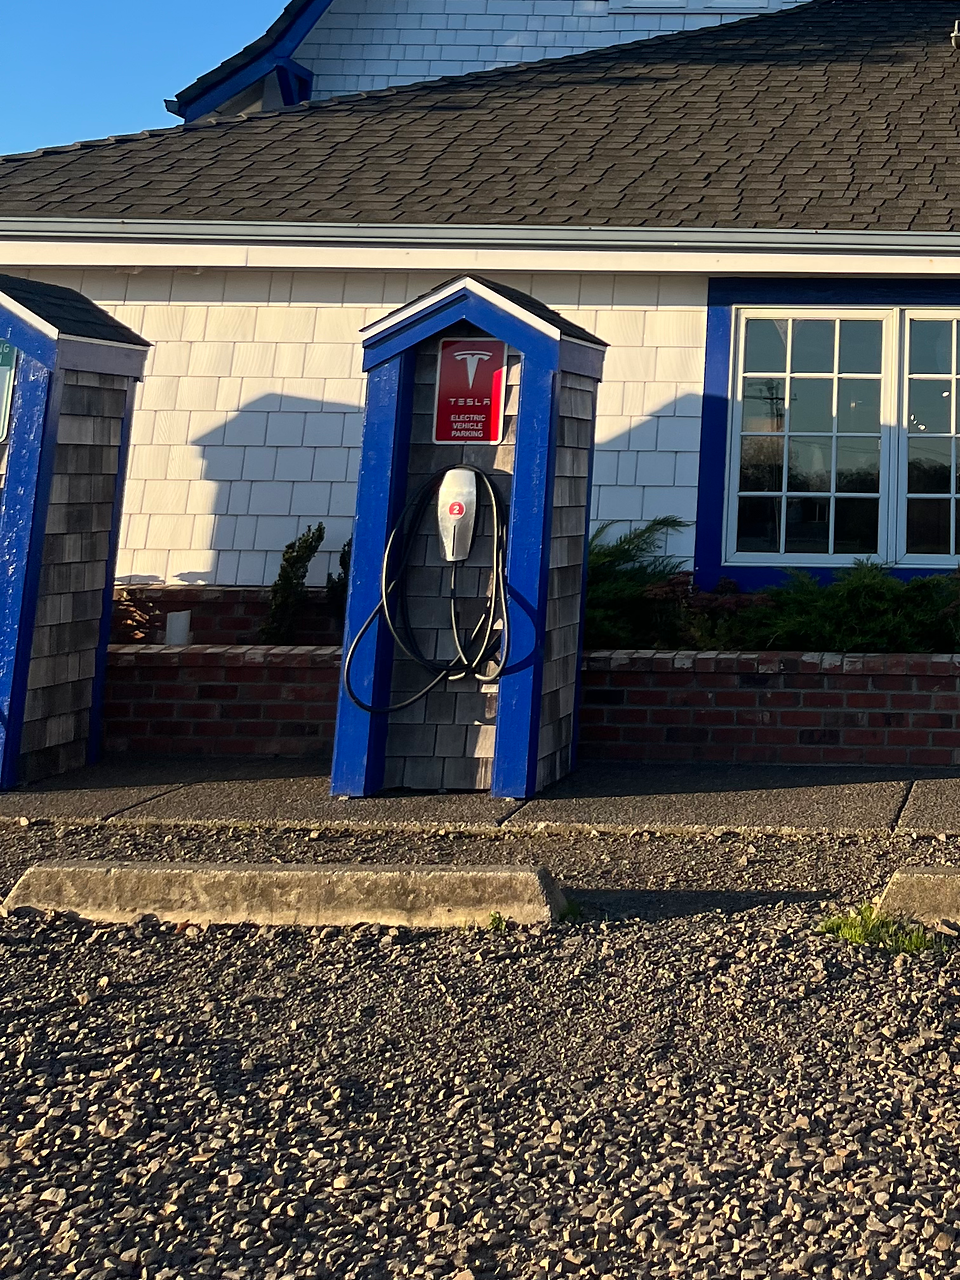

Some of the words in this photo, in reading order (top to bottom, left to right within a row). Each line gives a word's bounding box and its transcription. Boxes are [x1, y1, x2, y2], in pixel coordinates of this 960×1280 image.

[449, 398, 491, 406] TESLA
[450, 414, 486, 422] ELECTRIC
[452, 422, 483, 430] VEHICLE
[453, 505, 460, 514] 2
